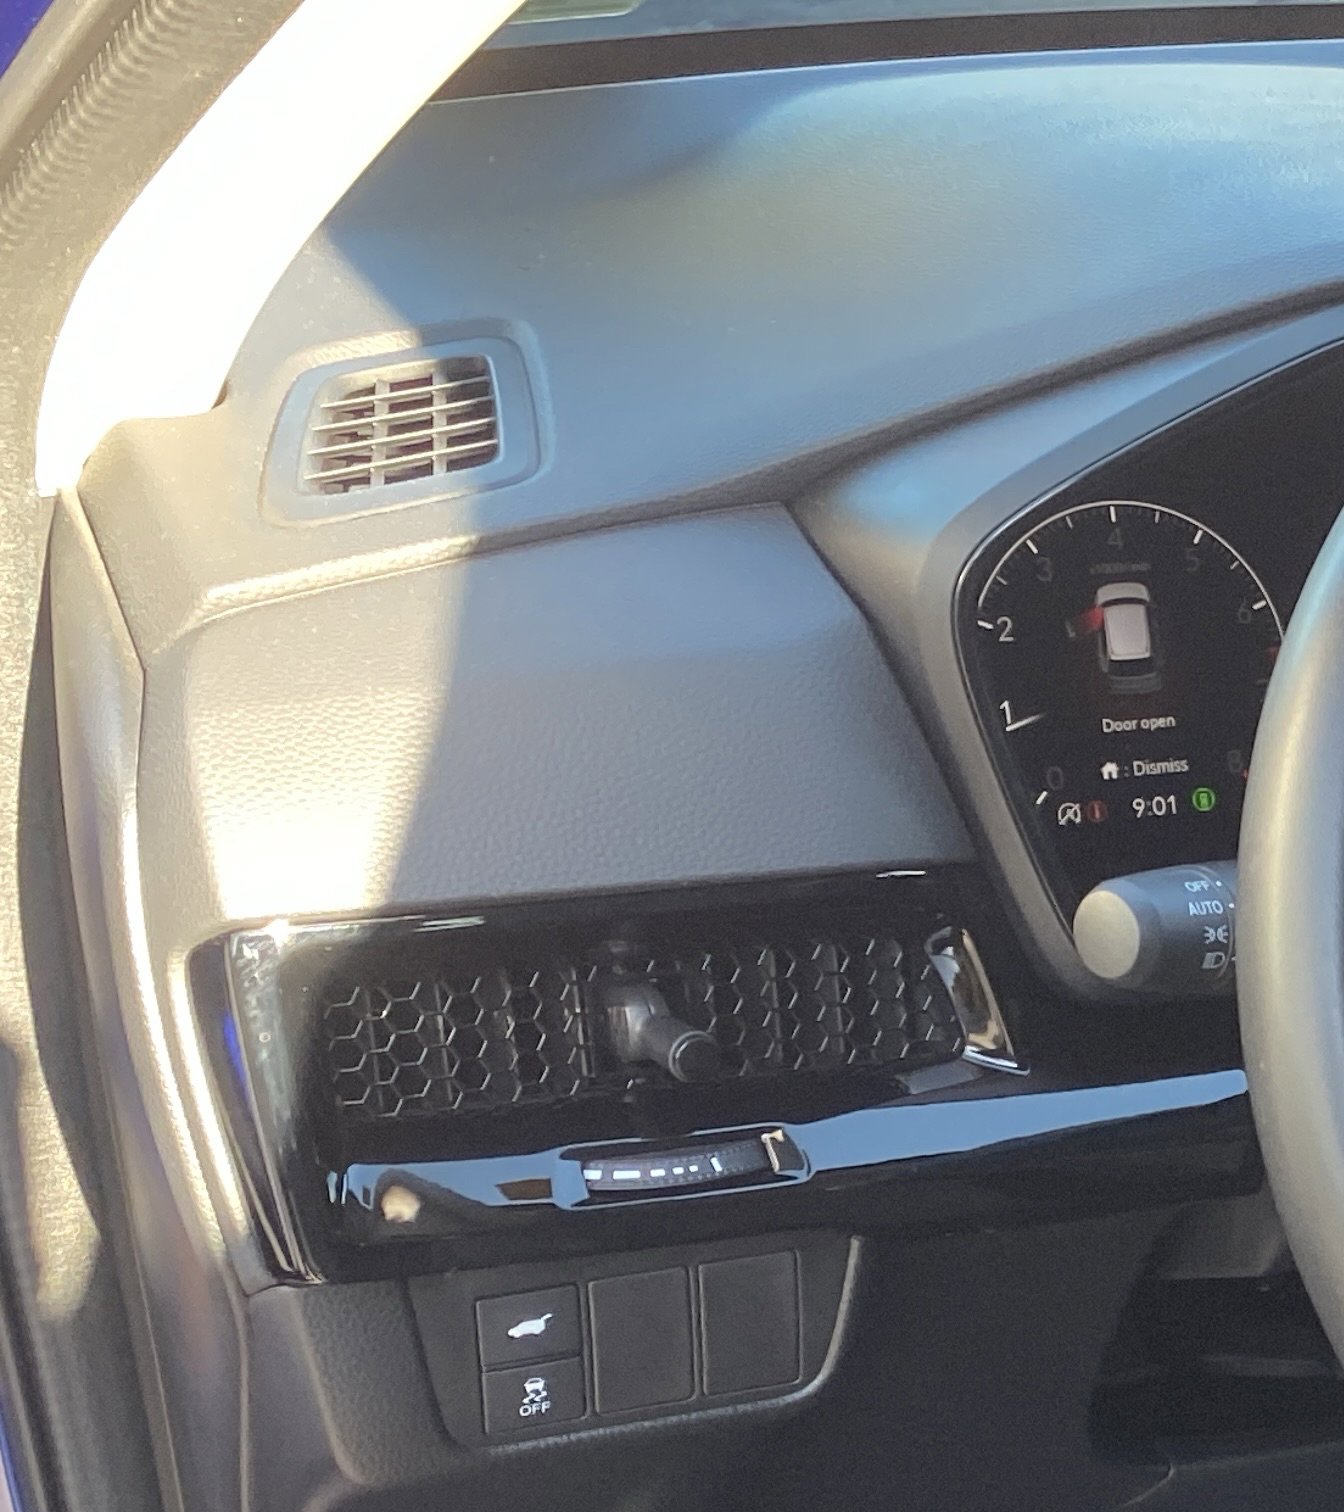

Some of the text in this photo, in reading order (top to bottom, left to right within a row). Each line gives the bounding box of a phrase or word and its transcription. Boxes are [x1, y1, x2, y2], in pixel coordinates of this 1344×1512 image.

[1107, 526, 1124, 549] 4
[996, 616, 1015, 643] 2
[999, 699, 1012, 725] 1
[1101, 714, 1177, 734] Door open
[1132, 758, 1189, 777] Dismiss
[1131, 794, 1178, 819] 9:01
[1184, 881, 1210, 893] OFF
[1187, 900, 1224, 916] AUTO
[518, 1400, 552, 1419] OFF
